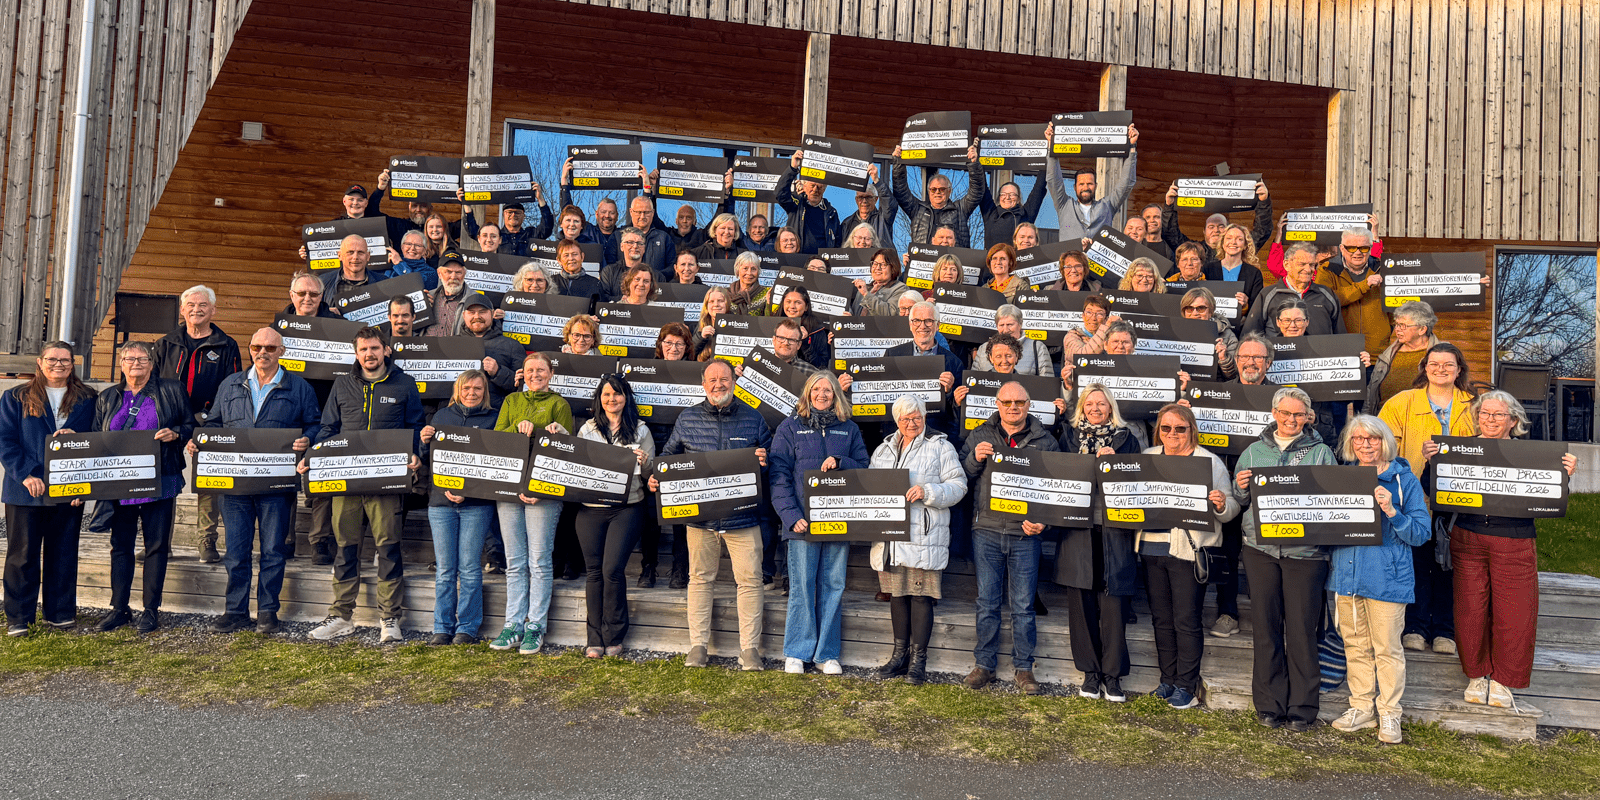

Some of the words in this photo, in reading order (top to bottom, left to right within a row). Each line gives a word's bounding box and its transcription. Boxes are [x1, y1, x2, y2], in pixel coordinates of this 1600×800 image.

[349, 292, 370, 302] stbank
[285, 337, 320, 348] STADSBYGD
[1156, 341, 1196, 351] SENIORDANS
[761, 358, 782, 374] stbank
[1299, 359, 1347, 370] HUSFLIDSLAG
[1330, 371, 1354, 379] 2026
[563, 376, 597, 386] HELSELAG
[750, 371, 779, 394] HASSELVIKA
[1116, 377, 1158, 387] IDRETTSLAG
[742, 381, 784, 410] GAVETILDELING
[1199, 409, 1217, 418] INDRE
[1245, 412, 1259, 422] HALL
[1262, 414, 1271, 422] OF
[1199, 421, 1253, 434] GAVETILDELING
[550, 441, 575, 451] stbank
[1452, 445, 1484, 454] stbank
[93, 458, 132, 467] KUNSTLAG
[480, 456, 518, 468] VELFORENING
[670, 461, 695, 470] stbank
[1005, 455, 1030, 465] stbank
[206, 465, 248, 475] GAVETILDELING
[318, 468, 367, 479] GAVETILDELING
[439, 464, 486, 478] GAVETILDELING
[491, 471, 509, 480] 2026
[1451, 464, 1476, 476] INDRE
[1482, 467, 1507, 478] FOSEN
[1516, 469, 1552, 480] BRASS
[60, 472, 114, 482] GAVETILDELING
[539, 472, 587, 487] GAVETILDELING
[592, 480, 608, 490] 2026
[703, 476, 741, 487] TEATERLAG
[820, 478, 846, 486] stbank
[1269, 475, 1299, 483] stbank
[1038, 480, 1081, 490] SMÅBÅTLAG
[1450, 480, 1517, 494] GAVETILDELING
[1525, 485, 1550, 494] 2026
[672, 492, 719, 503] GAVETILDELING
[850, 496, 898, 507] HEIMBYGDSLAG
[999, 488, 1050, 502] GAVETILDELING
[1057, 493, 1077, 504] 2026
[1114, 495, 1169, 506] GAVETILDELING
[1174, 497, 1195, 508] 2026
[1266, 497, 1300, 506] HINDREM
[1305, 496, 1365, 506] STAVKIRKELAG
[819, 510, 867, 519] GAVETILDELING
[874, 510, 891, 519] 2026
[1270, 510, 1323, 521] GAVETILDELING
[1329, 511, 1350, 521] 2026
